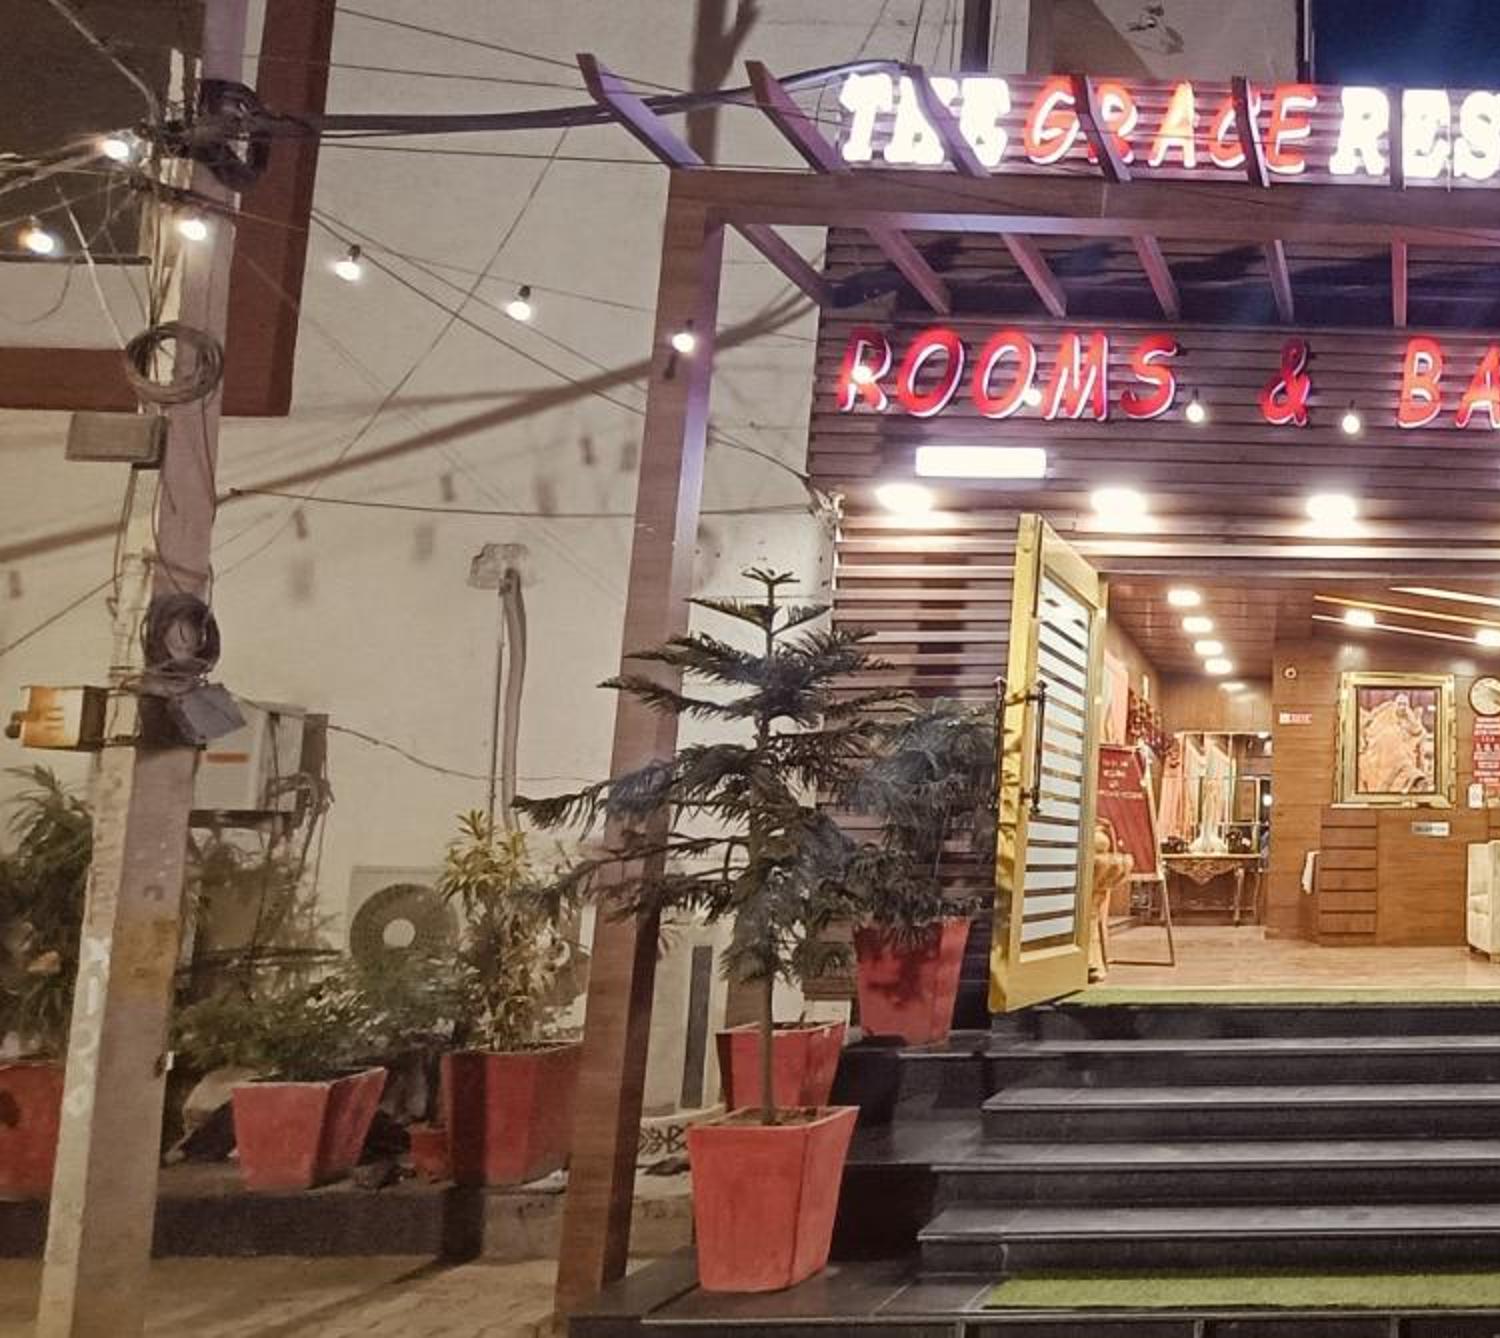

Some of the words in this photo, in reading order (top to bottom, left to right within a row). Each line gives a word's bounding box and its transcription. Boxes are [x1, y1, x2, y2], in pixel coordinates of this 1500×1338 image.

[1024, 75, 1317, 172] GRACE
[837, 325, 1179, 421] ROOMS
[1262, 338, 1311, 427] &
